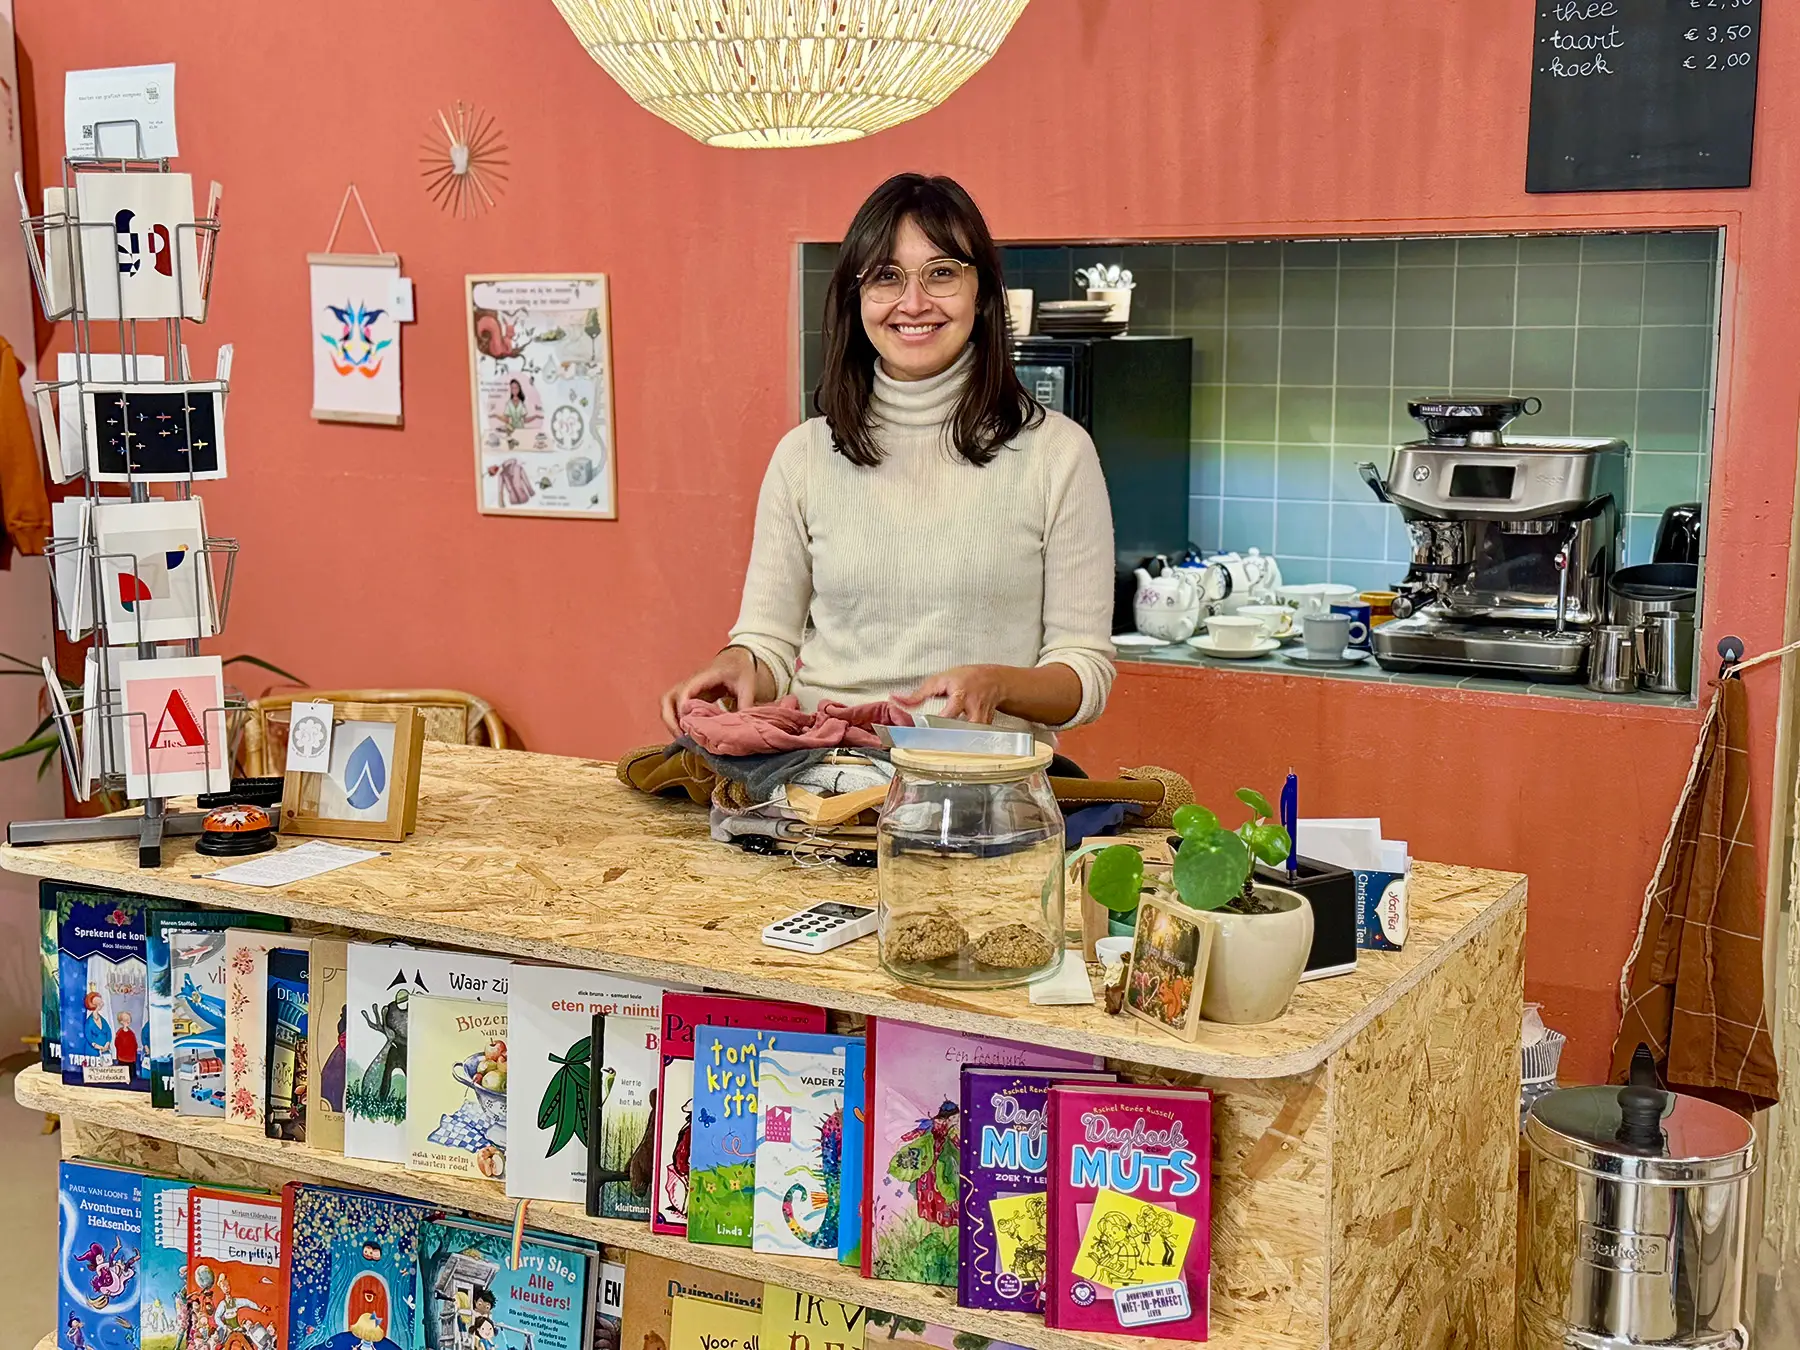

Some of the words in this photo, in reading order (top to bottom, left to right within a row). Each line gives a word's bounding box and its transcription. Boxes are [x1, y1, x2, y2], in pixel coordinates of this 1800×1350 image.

[1553, 1, 1618, 21] thee
[1550, 25, 1625, 50] taart
[1683, 28, 1699, 41] €
[1706, 25, 1752, 43] 3,50
[1549, 53, 1614, 77] koek
[1683, 56, 1697, 69] €
[1705, 53, 1751, 71] 2,00
[1357, 873, 1369, 925] Christmas
[74, 927, 114, 939] Sprekend
[116, 931, 127, 940] de
[129, 932, 146, 941] kon
[1356, 928, 1367, 944] Tea
[449, 972, 488, 991] Waar
[492, 978, 509, 995] zij
[551, 999, 584, 1013] eten
[589, 1002, 618, 1016] met
[456, 1015, 508, 1032] Blozen
[706, 1059, 759, 1093] krul
[800, 1076, 835, 1087] VADER
[1002, 1085, 1028, 1096] Rachel
[723, 1089, 758, 1118] sta
[1093, 1103, 1118, 1114] Rachel
[1120, 1103, 1144, 1113] Renée
[1146, 1105, 1175, 1120] Russell
[1080, 1112, 1189, 1160] Dagboek
[995, 1173, 1021, 1183] ZOEK
[1070, 1144, 1200, 1197] MUTS
[69, 1183, 87, 1194] PAUL
[88, 1187, 103, 1196] VAN
[104, 1189, 128, 1200] LOON'S
[80, 1198, 133, 1218] Avonturen
[614, 1202, 651, 1215] kluitman
[87, 1215, 141, 1234] Heksenbos
[222, 1218, 263, 1242] Mees
[717, 1223, 743, 1236] Linda
[547, 1255, 577, 1283] Slee
[528, 1273, 555, 1291] Alle
[510, 1285, 571, 1311] kleuters!
[604, 1279, 622, 1308] EN
[794, 1292, 829, 1327] IK
[700, 1334, 739, 1350] Voor
